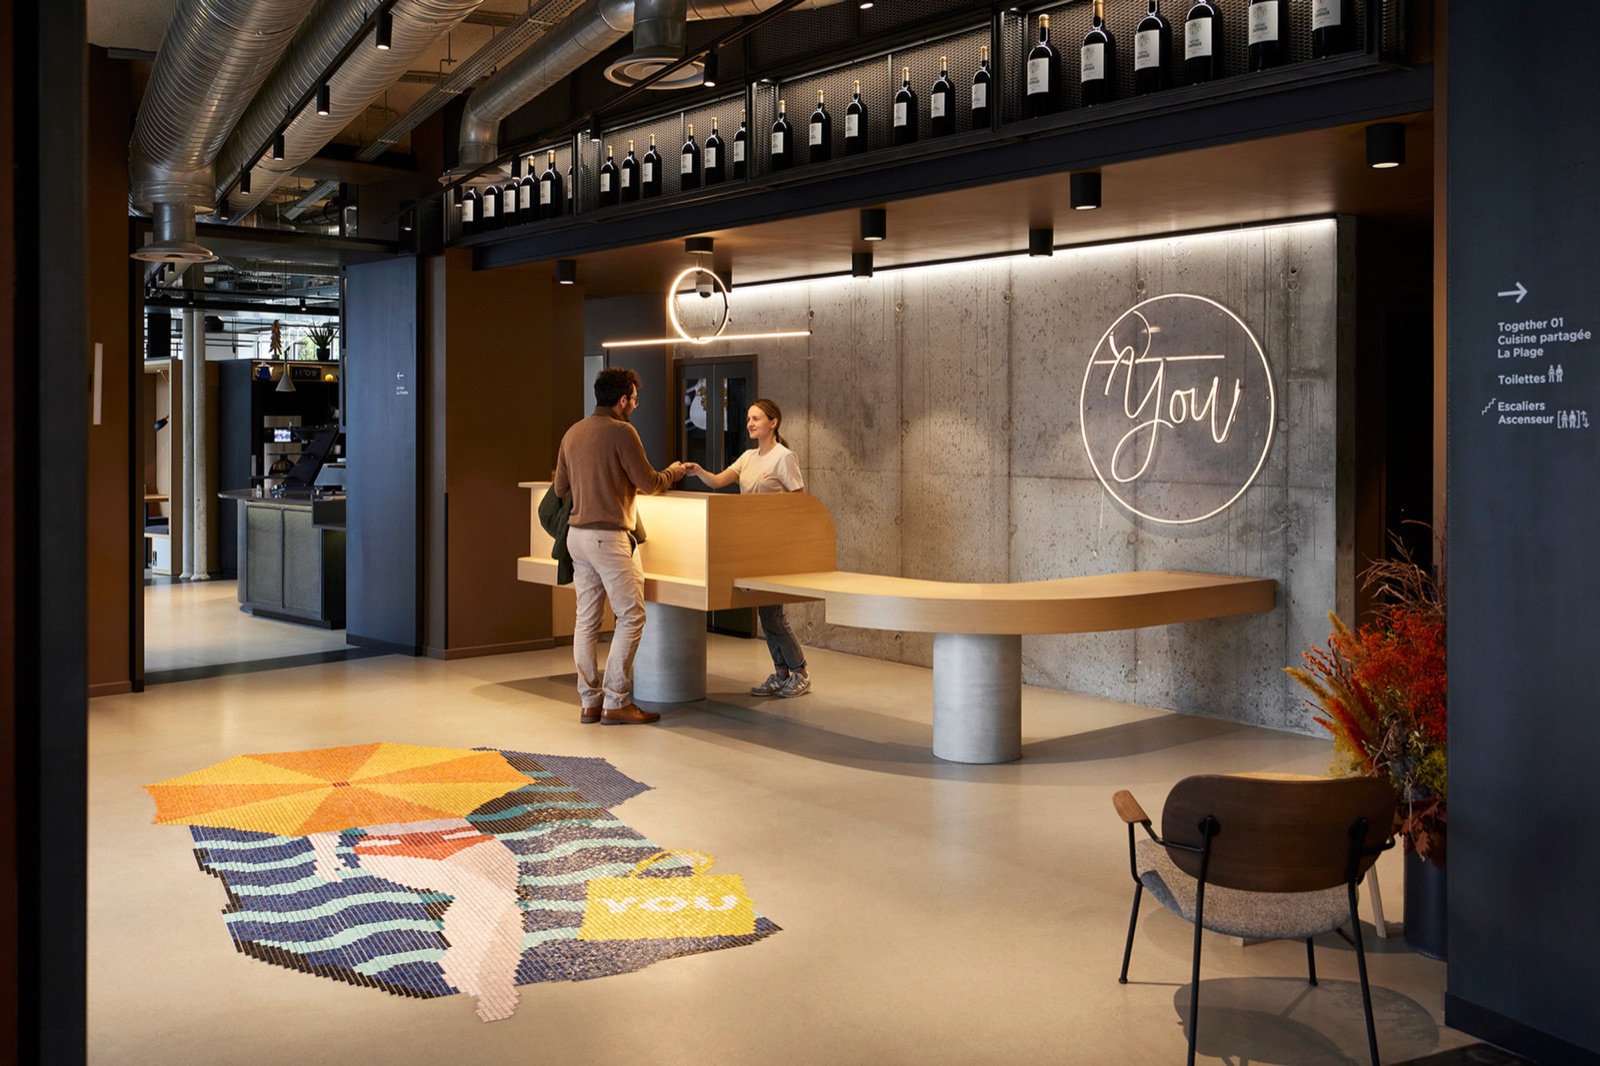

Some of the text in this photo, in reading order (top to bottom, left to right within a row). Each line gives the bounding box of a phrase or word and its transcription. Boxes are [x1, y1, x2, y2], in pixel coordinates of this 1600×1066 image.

[1498, 317, 1564, 333] Together 01
[1497, 329, 1592, 345] Cuisine partagée
[1497, 347, 1544, 359] La Plage
[1498, 374, 1546, 385] Toilettes
[1498, 400, 1546, 412] Escaliers
[1104, 345, 1242, 483] You
[1498, 414, 1555, 425] Ascenseur
[596, 894, 739, 915] YOU
